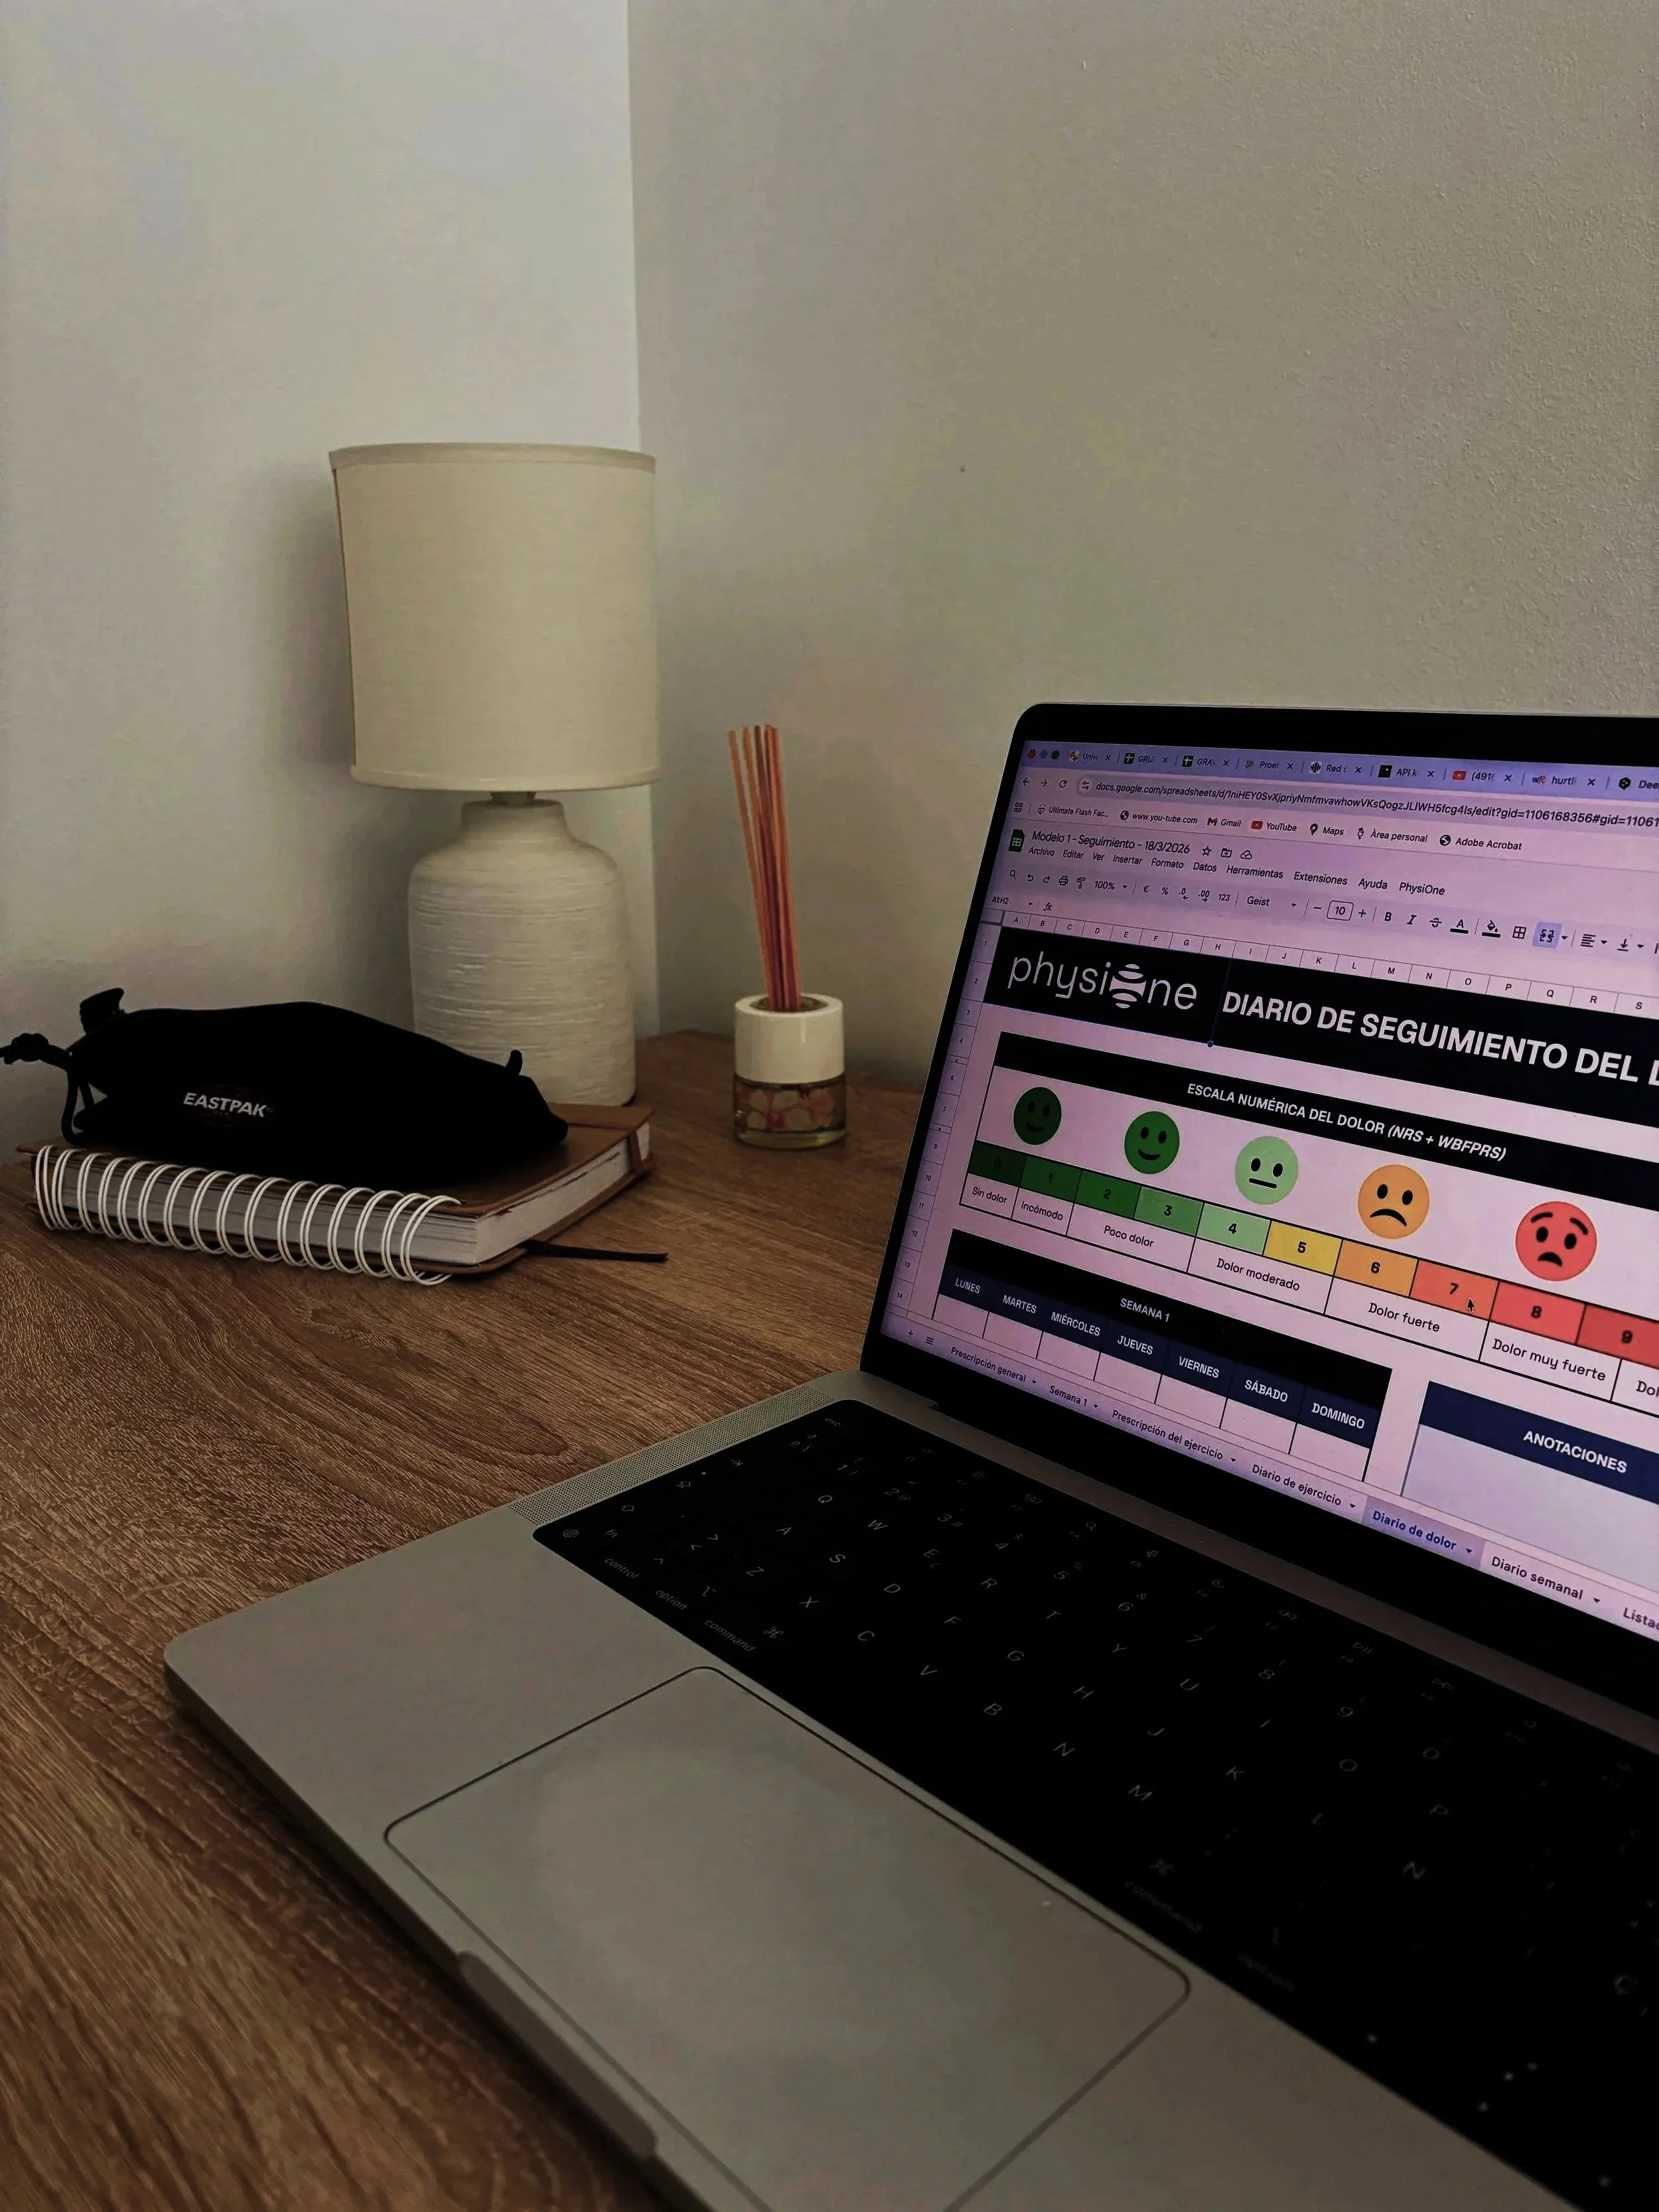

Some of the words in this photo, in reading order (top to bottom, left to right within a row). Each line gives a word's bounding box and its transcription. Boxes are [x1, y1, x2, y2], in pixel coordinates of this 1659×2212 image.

[1396, 768, 1411, 776] API
[1048, 806, 1074, 815] Ultimate
[1132, 812, 1198, 825] www.you-tube.com
[1220, 819, 1242, 828] Gmail
[1266, 822, 1297, 832] YouTube
[1323, 827, 1344, 836] Maps
[1032, 831, 1064, 843] Modelo
[1067, 834, 1071, 843] 1
[1078, 834, 1135, 849] Seguimiento
[1144, 840, 1190, 854] 18/3/2026
[1391, 834, 1428, 843] personal
[1455, 838, 1484, 848] Adobe
[1486, 840, 1522, 850] Acrobat
[1029, 847, 1055, 857] Archivo
[1063, 849, 1084, 859] Editar
[1093, 852, 1105, 861] Ver
[1113, 854, 1143, 865] Insertar
[1151, 858, 1184, 869] Formato
[1193, 862, 1217, 872] Datos
[1226, 865, 1283, 879] Herramientas
[1293, 871, 1348, 885] Extensiones
[1358, 878, 1388, 891] Ayuda
[1400, 882, 1445, 896] PhysiOne
[1094, 880, 1116, 891] 100%
[1247, 895, 1270, 907] Geist
[1335, 906, 1346, 915] 10
[1387, 966, 1396, 976] M
[1426, 972, 1433, 980] N
[1222, 991, 1312, 1025] DIARIO
[1317, 1006, 1356, 1033] DE
[1360, 1013, 1568, 1069] SEGUIMIENTO
[1575, 1047, 1638, 1082] DEL
[183, 1092, 267, 1118] EASTPAK
[1187, 1083, 1235, 1104] ESCALA
[1238, 1093, 1305, 1118] NUMÉRICA
[1309, 1108, 1334, 1124] DEL
[1336, 1114, 1385, 1134] DOLOR
[1388, 1124, 1424, 1142] (NRS
[1426, 1136, 1434, 1145] +
[1437, 1135, 1507, 1161] WBFPRS)
[972, 1186, 985, 1197] Sin
[986, 1191, 1007, 1204] dolor
[1021, 1201, 1064, 1220] Incómodo
[1104, 1225, 1127, 1240] Poco
[1129, 1234, 1154, 1248] dolor
[1048, 1173, 1053, 1183] 1
[1104, 1189, 1111, 1199] 2
[1164, 1205, 1173, 1216] 3
[1228, 1223, 1237, 1234] 4
[1297, 1241, 1307, 1253] 5
[1370, 1262, 1380, 1274] 6
[1450, 1282, 1459, 1294] 7
[1532, 1305, 1542, 1318] 8
[1621, 1330, 1633, 1344] 9
[1216, 1258, 1244, 1275] Dolor
[1246, 1269, 1300, 1291] moderado
[955, 1278, 981, 1294] LUNES
[1003, 1294, 1037, 1314] MARTES
[1119, 1297, 1163, 1320] SEMANA
[1165, 1313, 1170, 1322] 1
[1050, 1311, 1101, 1337] MIÉRCOLES
[1368, 1302, 1400, 1320] Dolor
[1403, 1312, 1440, 1332] fuerte
[1117, 1335, 1153, 1355] JUEVES
[950, 1347, 996, 1371] Prescripción
[997, 1366, 1027, 1382] general
[1179, 1356, 1220, 1379] VIERNES
[1492, 1338, 1527, 1358] Dolor
[1530, 1351, 1559, 1370] muy
[1562, 1359, 1606, 1381] fuerte
[1050, 1385, 1081, 1404] Semana
[1083, 1398, 1088, 1407] 1
[1244, 1379, 1288, 1402] SÁBADO
[1311, 1402, 1365, 1430] DOMINGO
[1112, 1410, 1166, 1438] Prescripción
[1168, 1432, 1182, 1445] del
[1184, 1439, 1223, 1461] ejercicio
[1522, 1430, 1628, 1474] ANOTACIONES
[1252, 1464, 1281, 1483] Diario
[1283, 1475, 1296, 1488] de
[1298, 1483, 1341, 1506] ejercicio
[818, 1495, 833, 1504] Q
[776, 1526, 792, 1536] A
[868, 1520, 889, 1530] W
[1372, 1511, 1406, 1531] Diario
[1409, 1524, 1423, 1538] de
[1425, 1531, 1457, 1551] dolor
[605, 1558, 640, 1579] control
[830, 1554, 846, 1563] S
[746, 1566, 764, 1577] Z
[1491, 1556, 1527, 1578] Diario
[1530, 1572, 1583, 1600] semanal
[884, 1584, 901, 1593] D
[655, 1589, 687, 1610] option
[799, 1597, 819, 1608] X
[704, 1620, 757, 1652] command
[857, 1631, 875, 1641] C
[1007, 1651, 1025, 1661] G
[920, 1665, 938, 1675] V
[1073, 1686, 1094, 1698] H
[983, 1703, 1003, 1715] B
[1053, 1742, 1075, 1757] N
[1127, 1784, 1153, 1803] M
